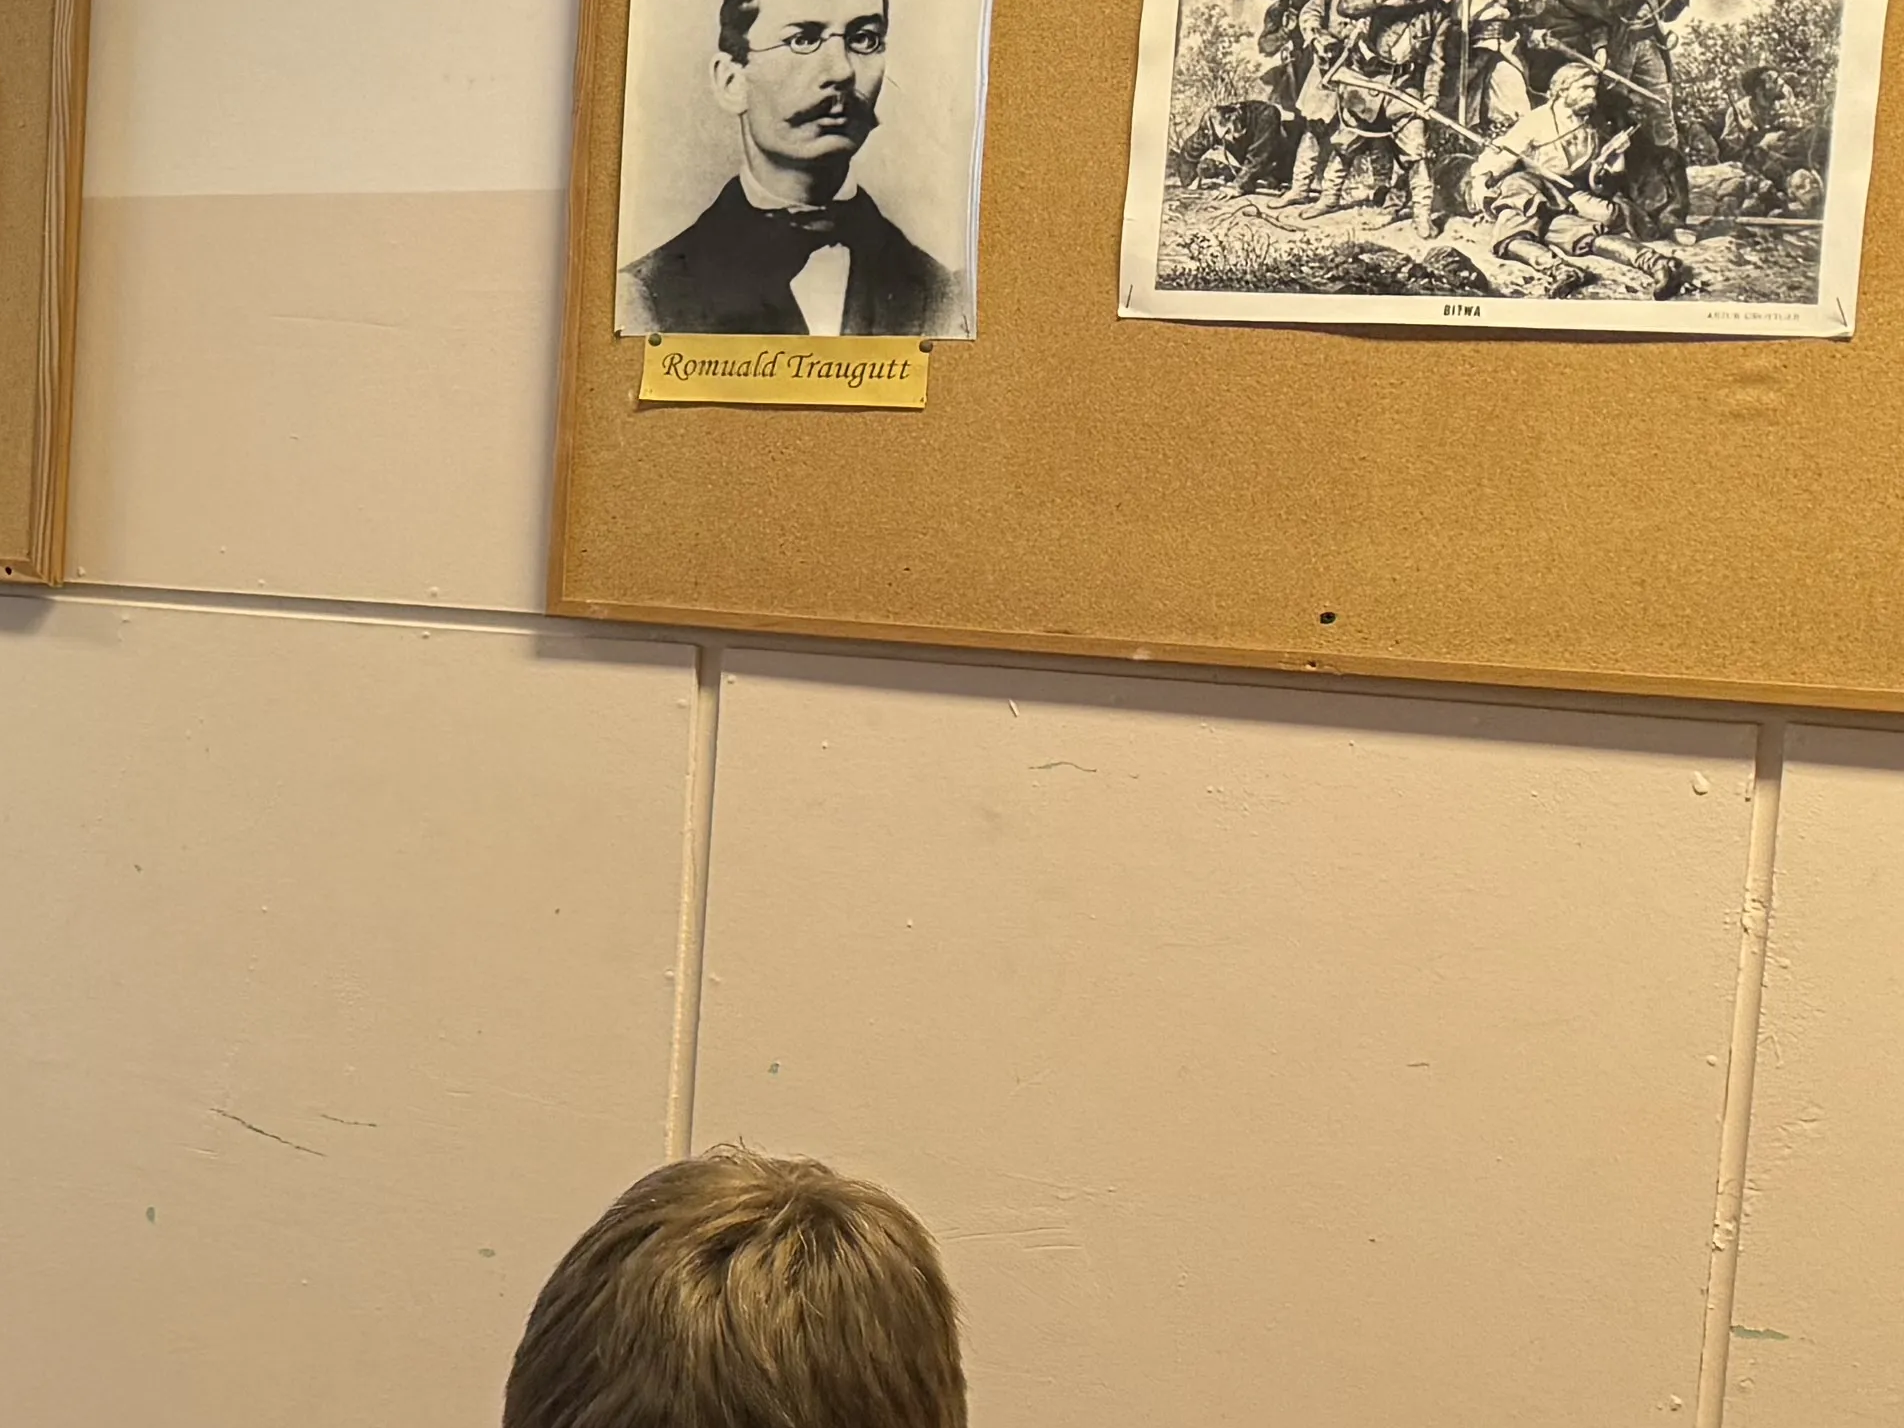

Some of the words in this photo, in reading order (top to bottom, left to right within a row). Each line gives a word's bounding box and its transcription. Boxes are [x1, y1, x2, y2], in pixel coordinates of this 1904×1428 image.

[1443, 304, 1481, 317] BITWA
[661, 350, 785, 381] Romuald
[787, 352, 912, 388] Traugutt
